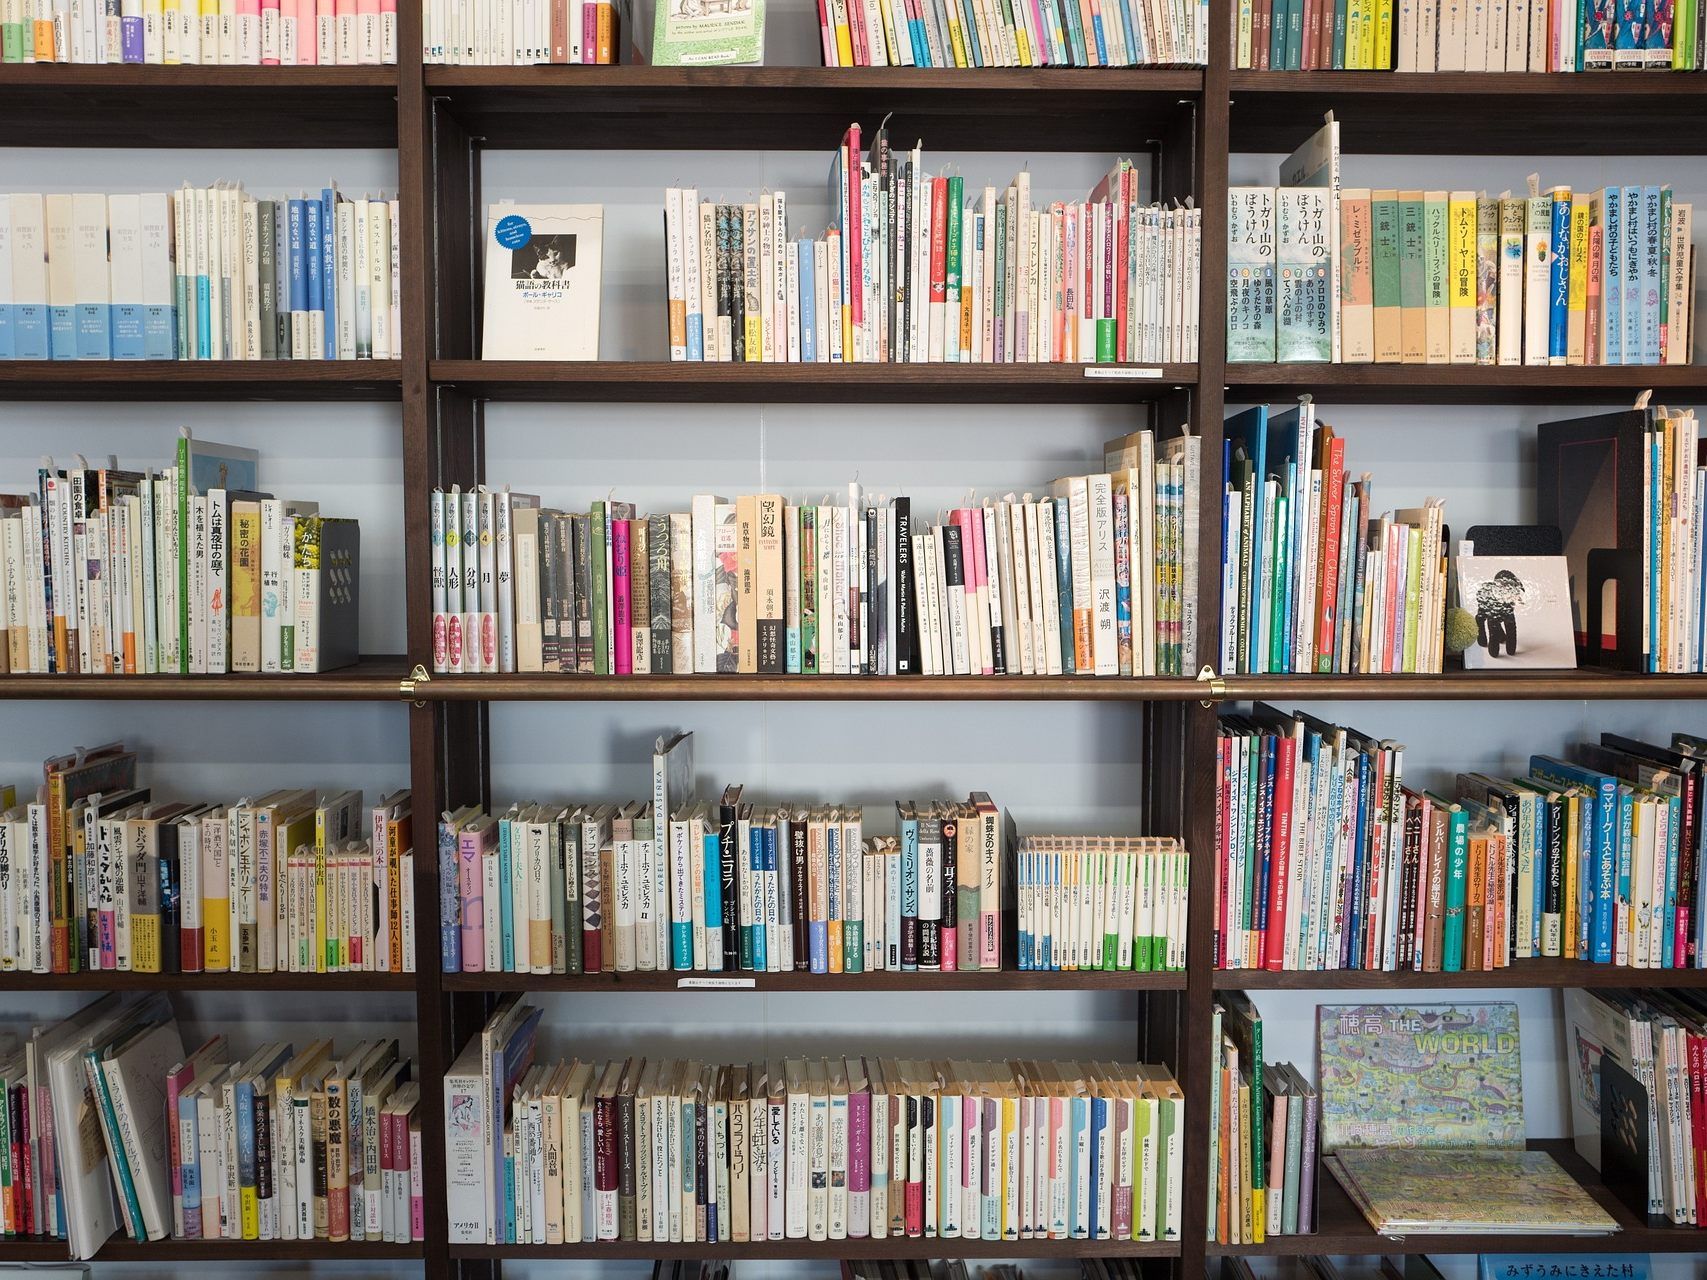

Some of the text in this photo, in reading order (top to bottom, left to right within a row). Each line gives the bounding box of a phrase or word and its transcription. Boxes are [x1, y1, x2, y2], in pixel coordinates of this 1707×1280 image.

[1245, 194, 1258, 244] ぼうけん
[1260, 194, 1272, 256] トガリ山の
[1297, 194, 1310, 244] ぼうけん
[1312, 195, 1324, 257] トガリ山の
[1352, 206, 1362, 265] レ・ミゼラブル
[1380, 206, 1390, 246] 三銃士
[1406, 206, 1416, 247] 三銃士
[1608, 194, 1619, 278] やかまし村の子どもたち
[1627, 192, 1639, 282] やかまし村はいつもにぎやか
[1646, 194, 1659, 278] やかまし村の春・夏・秋・冬
[324, 234, 333, 274] 須賀敦子
[746, 210, 757, 288] アブサンの置土産
[1432, 208, 1442, 299] ハックルベリー・フィンの冒険
[1459, 208, 1469, 297] トム・ソーヤーの冒険
[1556, 201, 1571, 306] あしながおじさん
[1675, 208, 1686, 291] 岩波 世界児童文学集
[515, 280, 570, 290] 猫語の教科書
[1242, 280, 1250, 330] 月夜のキノコ
[1254, 280, 1262, 330] ゆうだちの森
[1264, 280, 1273, 314] 風の草原
[1318, 280, 1326, 334] ウロロのひみつ
[73, 478, 84, 519] 田園の食卓
[1244, 480, 1251, 490] AN
[196, 506, 204, 560] 木を植えた男
[211, 501, 223, 577] トムは真夜中の庭で
[240, 519, 250, 568] 秘密の花園
[283, 526, 291, 560] ガラス蜘蛛
[742, 522, 751, 550] 唐草物語
[900, 516, 908, 564] TRAVELERS
[1095, 483, 1108, 552] 完全版アリス
[1326, 448, 1342, 602] The Silver Spoon for Children
[301, 532, 312, 568] かたち
[656, 520, 669, 572] うつろ舟
[448, 567, 459, 590] 人形
[466, 567, 476, 589] 分身
[482, 572, 490, 584] 月
[498, 572, 510, 584] 夢
[1099, 588, 1111, 630] 沢渡朔
[375, 814, 384, 865] 伊丹十三の本
[965, 826, 974, 854] 緑の家
[986, 816, 994, 864] 蜘蛛女のキス
[1266, 774, 1274, 863] ジス・イズ・ケープケネディ
[1521, 800, 1532, 874] あの年の春は早くきた
[86, 842, 96, 875] 加藤和彦
[114, 827, 124, 894] 風雲ジャズ帖の逆襲
[136, 826, 146, 906] ドバラダ門 山下洋輔
[259, 830, 269, 902] 赤塚不二夫の特集
[462, 840, 476, 863] エマ
[514, 826, 524, 880] ダロウェイ夫人
[533, 838, 542, 884] アフリカの日々
[720, 821, 734, 890] プチ・ニコラ
[794, 830, 804, 865] 壁抜け男
[906, 829, 914, 914] ヴァーミリオン・サンズ
[926, 848, 934, 894] 薔薇の名前
[1372, 835, 1381, 888] オリビア
[1432, 820, 1444, 908] シルバー・レイクの岸辺で
[1453, 822, 1465, 880] 農場の少年
[1473, 844, 1481, 904] ドリトル先生のサーカス
[1600, 793, 1614, 902] マザーグースとあそぶ本
[620, 842, 630, 910] チェーホフ・ユモレスカ
[641, 842, 651, 910] チェーホフ・ユモレスカ
[676, 832, 686, 922] ポケットから出てきたミステリー
[1486, 844, 1496, 906] ドリトル先生と秘密の湖
[1339, 1014, 1422, 1036] 穂高 THE
[1414, 1033, 1516, 1055] WORLD
[224, 1090, 234, 1148] アースダイバー
[239, 1094, 251, 1164] 大阪アースダイバー
[256, 1101, 266, 1163] 音楽のつつましい願い
[328, 1096, 341, 1144] 数の悪魔
[365, 1105, 377, 1175] 橋本治と内田樹
[622, 1103, 631, 1170] バースデイ・ストーリーズ
[716, 1120, 726, 1160] くちづけ
[772, 1106, 781, 1145] 愛している
[816, 1113, 824, 1170] あの薔薇を見てよ
[640, 1102, 648, 1201] ザ・スコット・フィッツジェラルド・ブック
[1506, 1262, 1634, 1278] みずうみにきえた村
